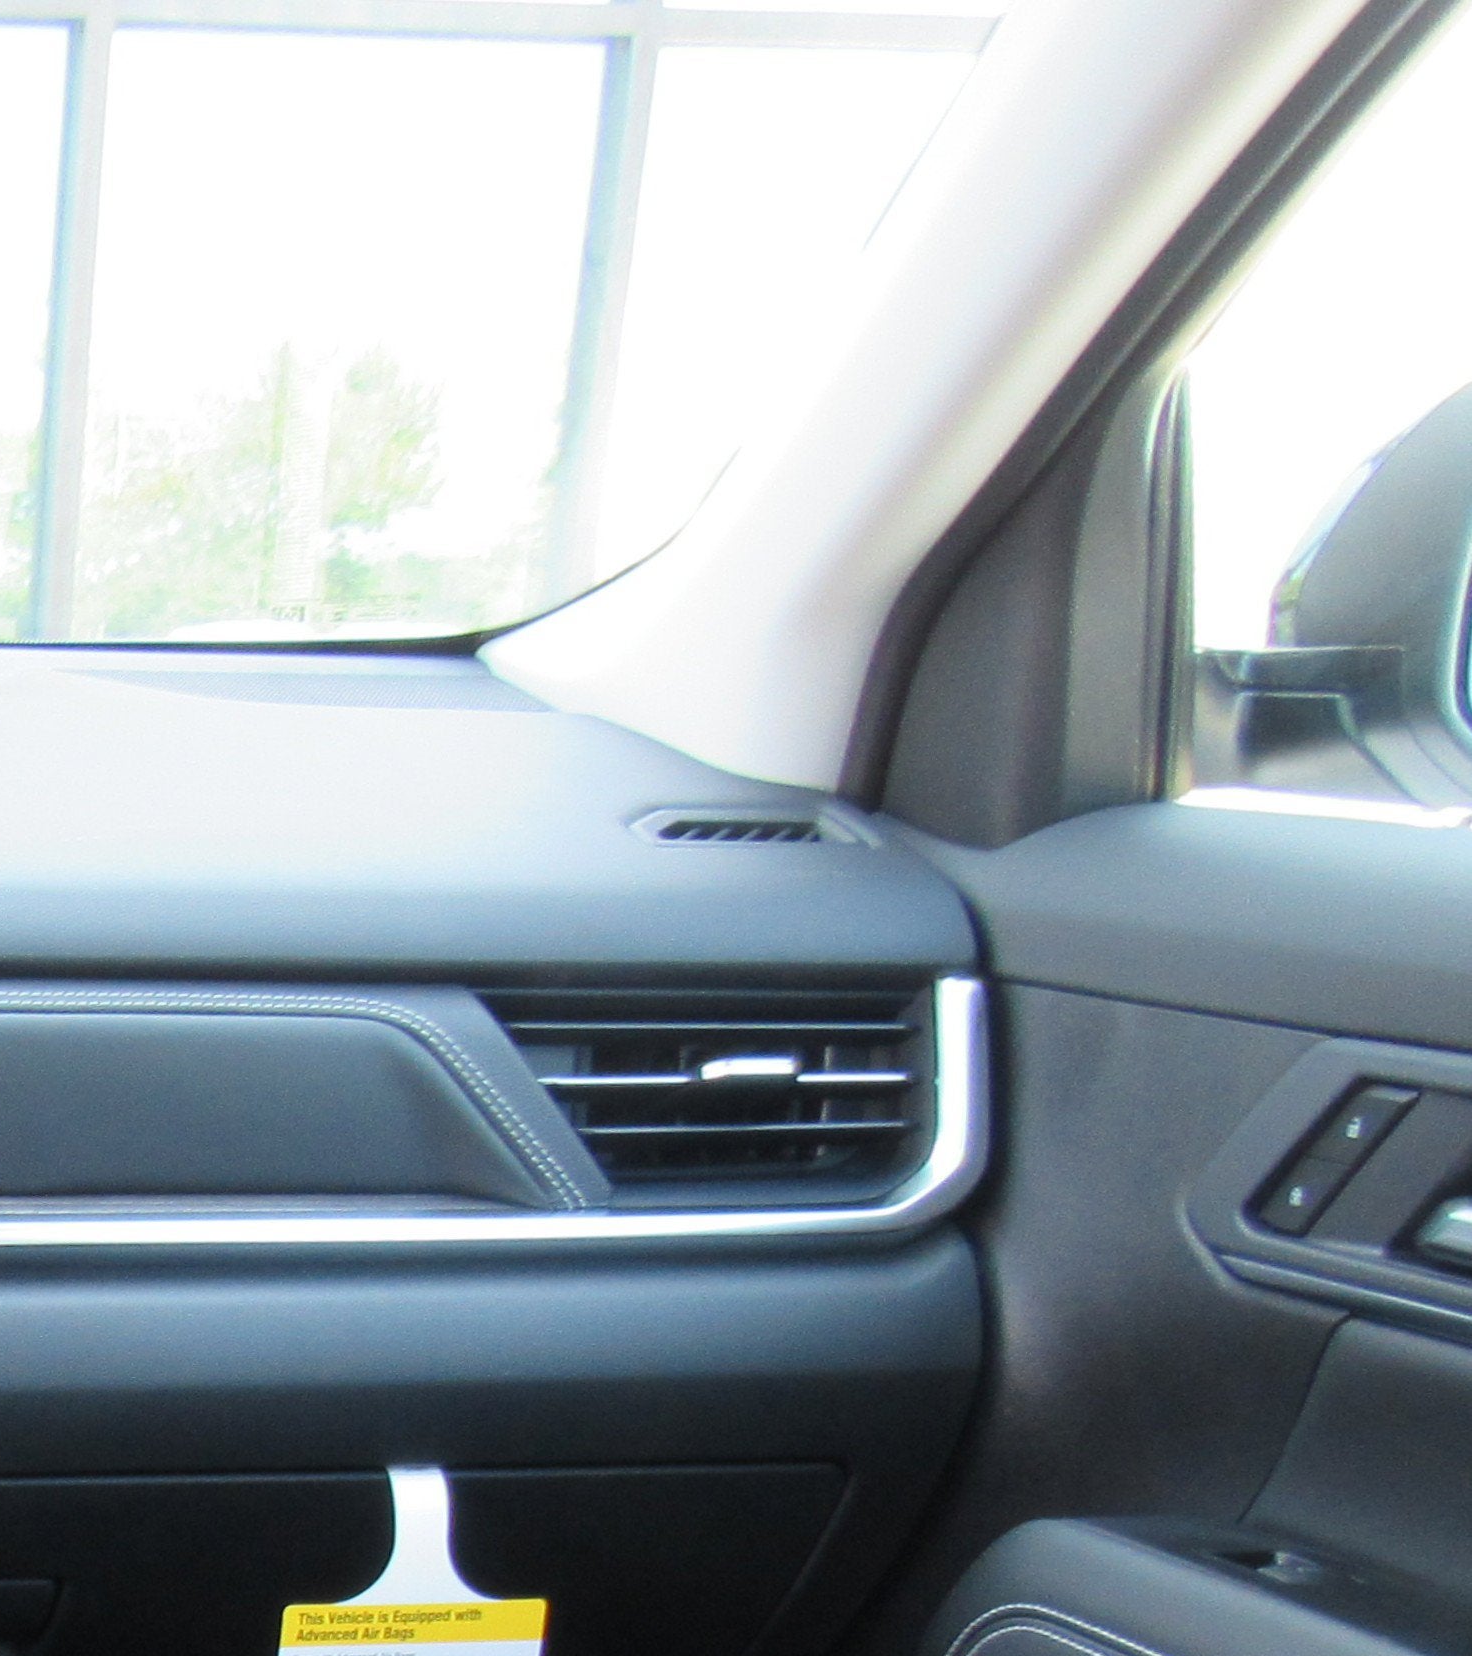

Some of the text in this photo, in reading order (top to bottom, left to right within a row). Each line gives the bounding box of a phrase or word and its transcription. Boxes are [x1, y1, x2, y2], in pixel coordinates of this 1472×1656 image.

[300, 1609, 481, 1624] This Vehicle is Equipped with
[297, 1627, 414, 1641] Advanced Air Bags
